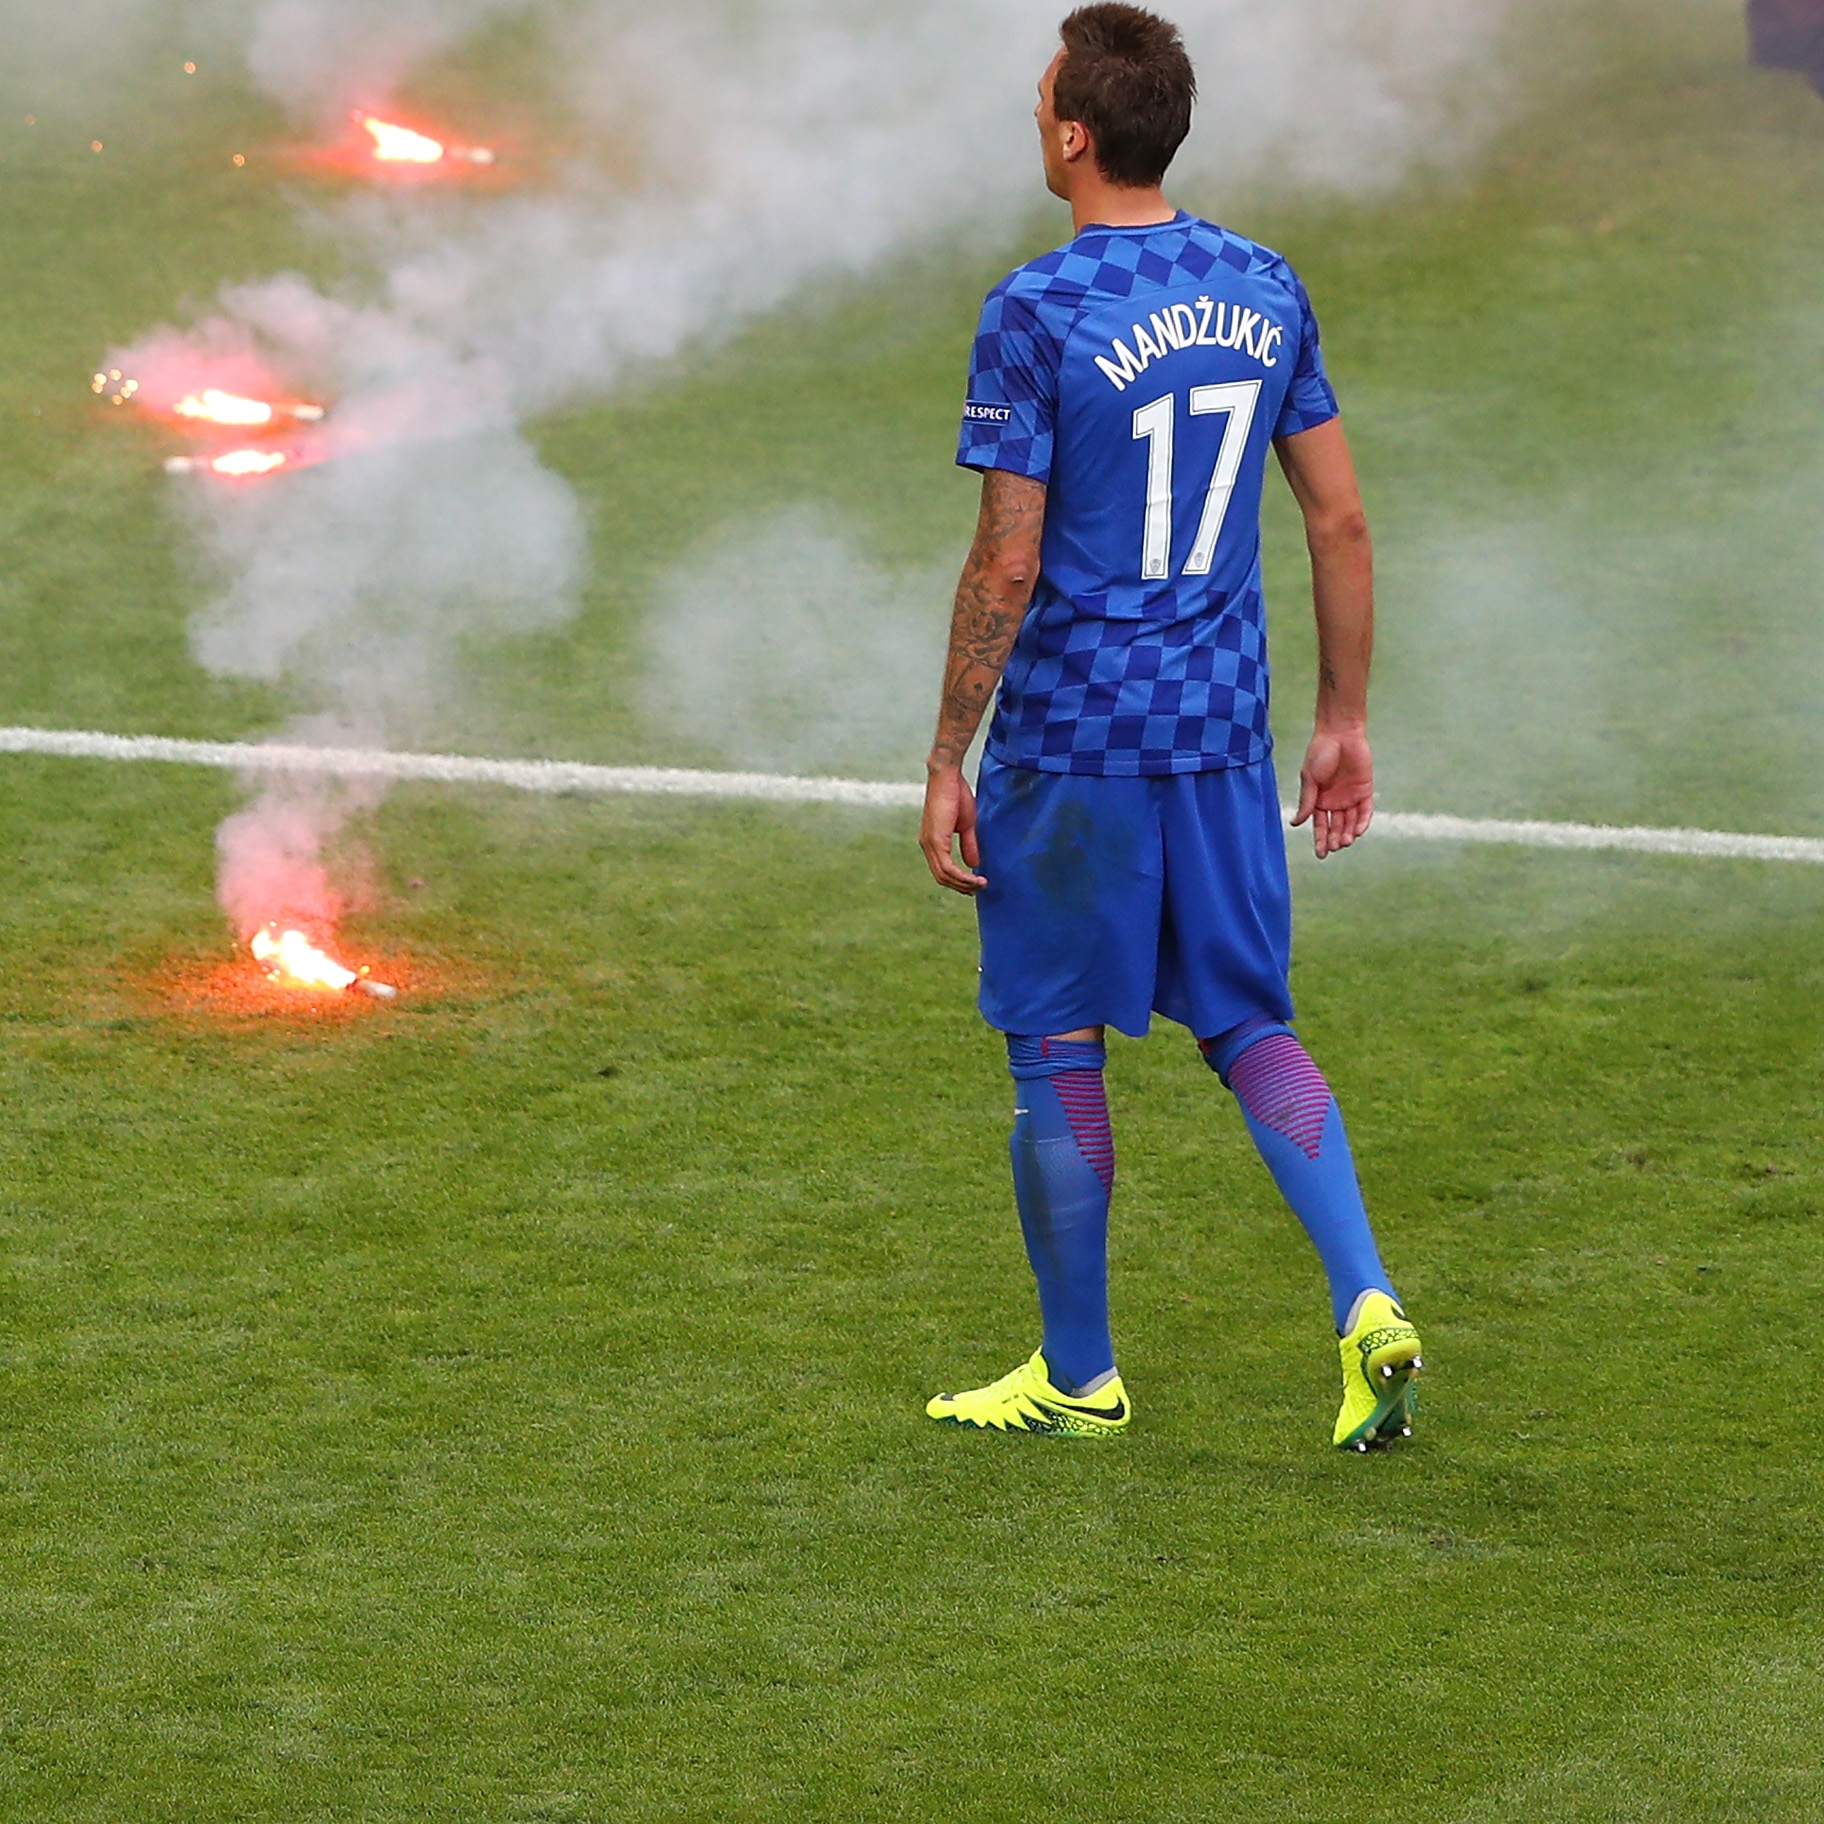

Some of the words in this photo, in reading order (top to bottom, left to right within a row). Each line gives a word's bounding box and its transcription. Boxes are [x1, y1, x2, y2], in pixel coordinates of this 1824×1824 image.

[1094, 295, 1283, 391] MANDŽUKIĆ
[964, 405, 1011, 421] RESPECT
[1132, 379, 1263, 580] 17
